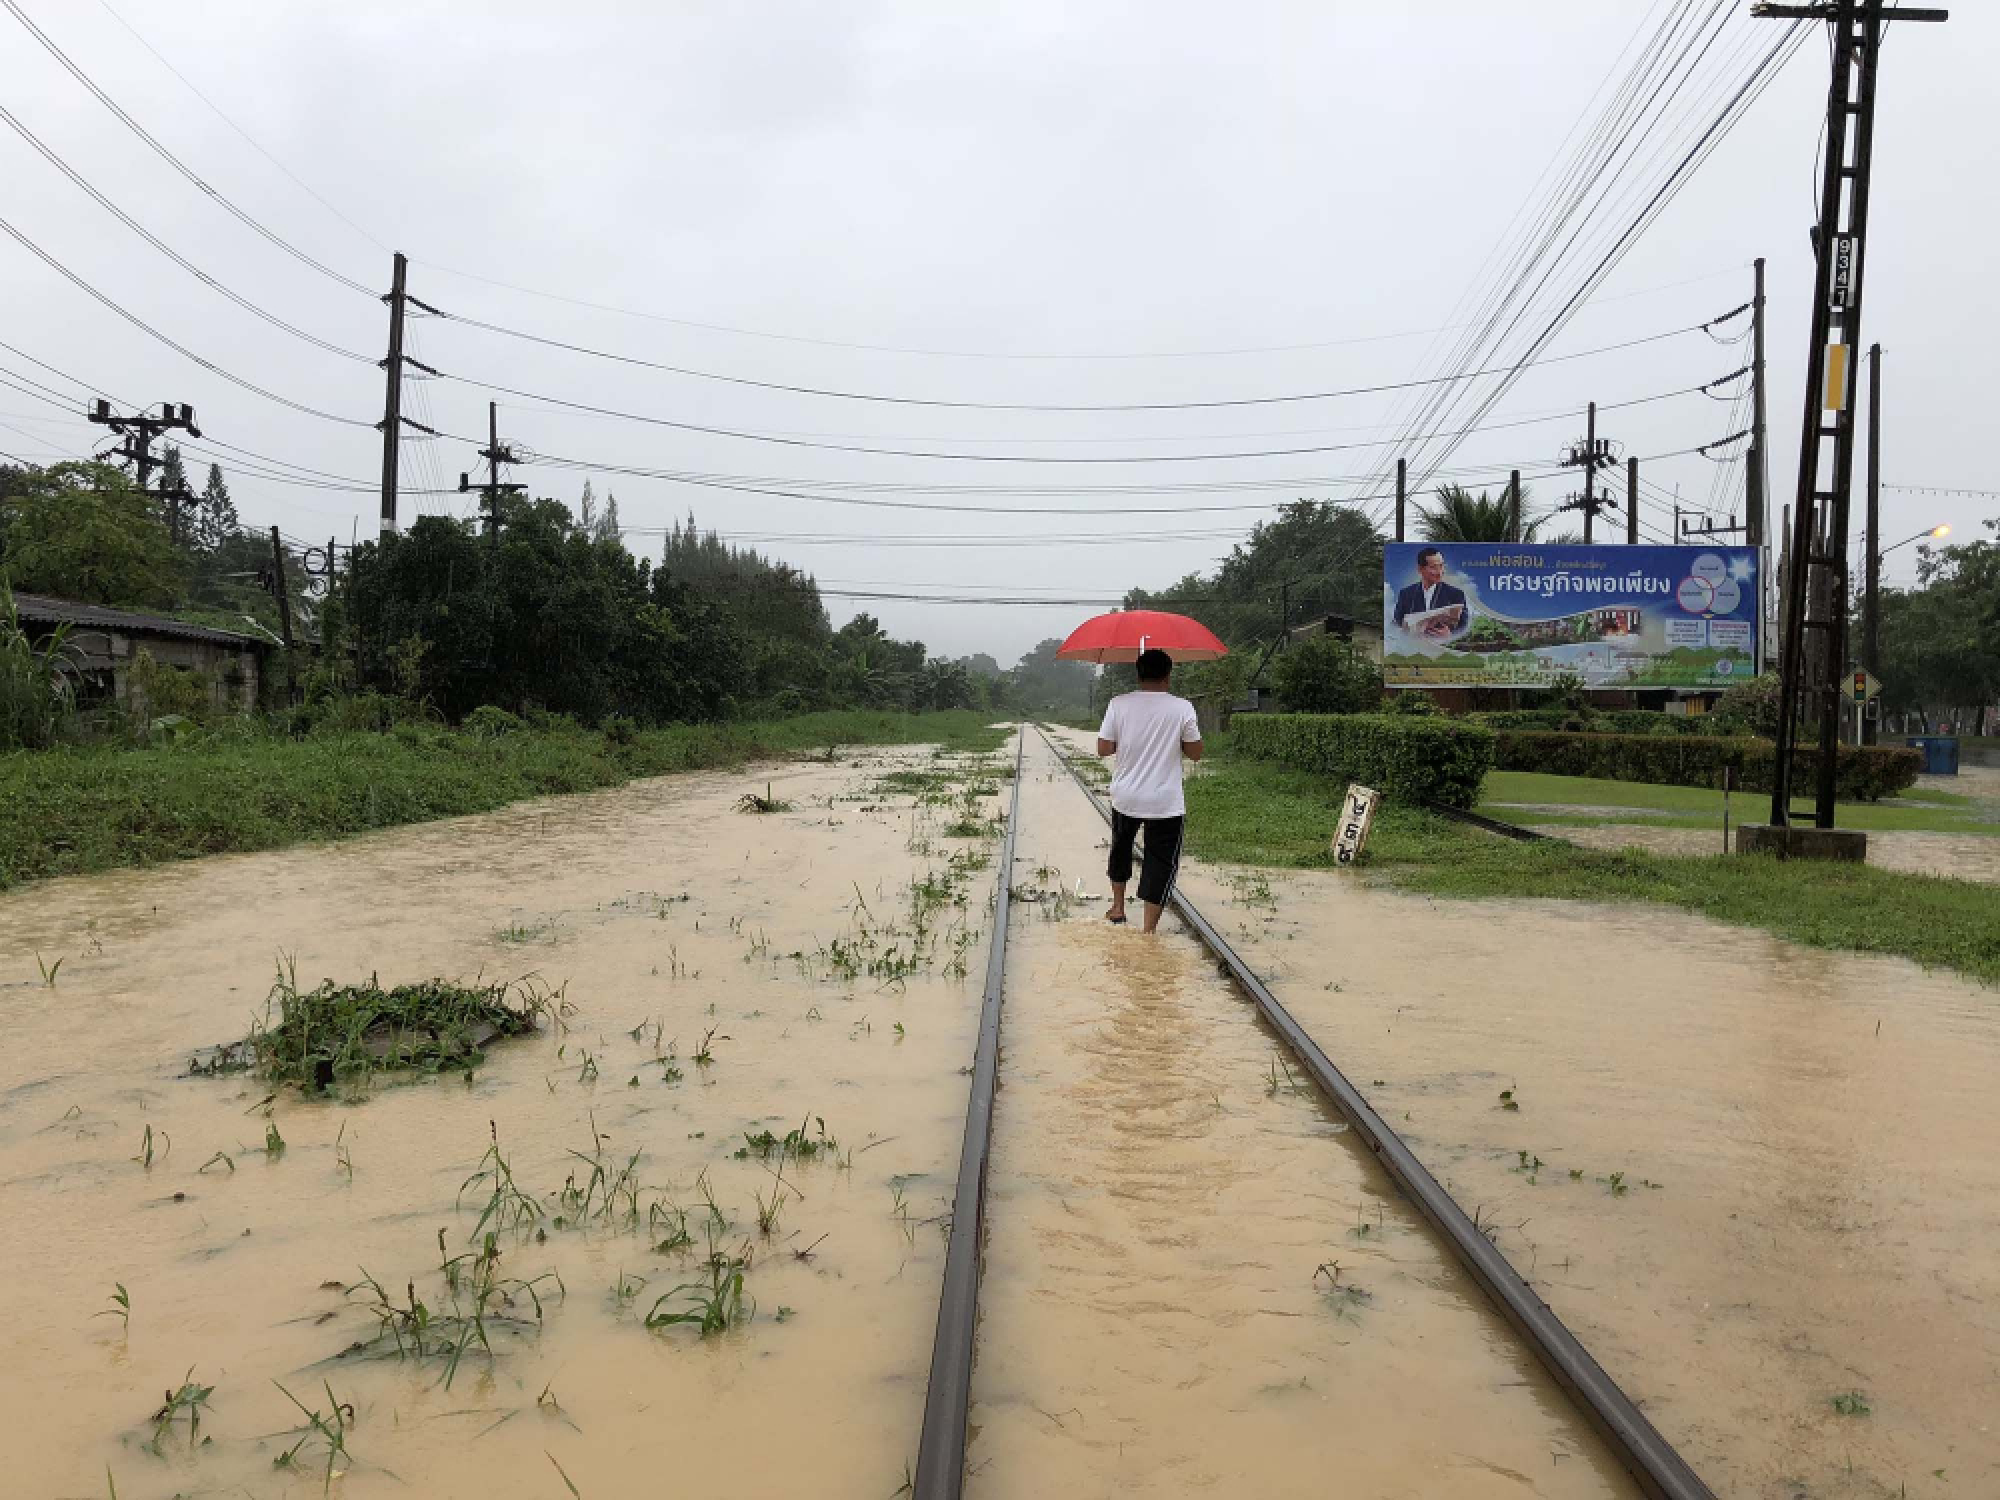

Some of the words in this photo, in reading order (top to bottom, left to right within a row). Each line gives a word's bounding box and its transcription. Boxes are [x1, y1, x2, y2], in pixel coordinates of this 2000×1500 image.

[1489, 569, 1671, 597] เศรษฐกิจพอเพียง
